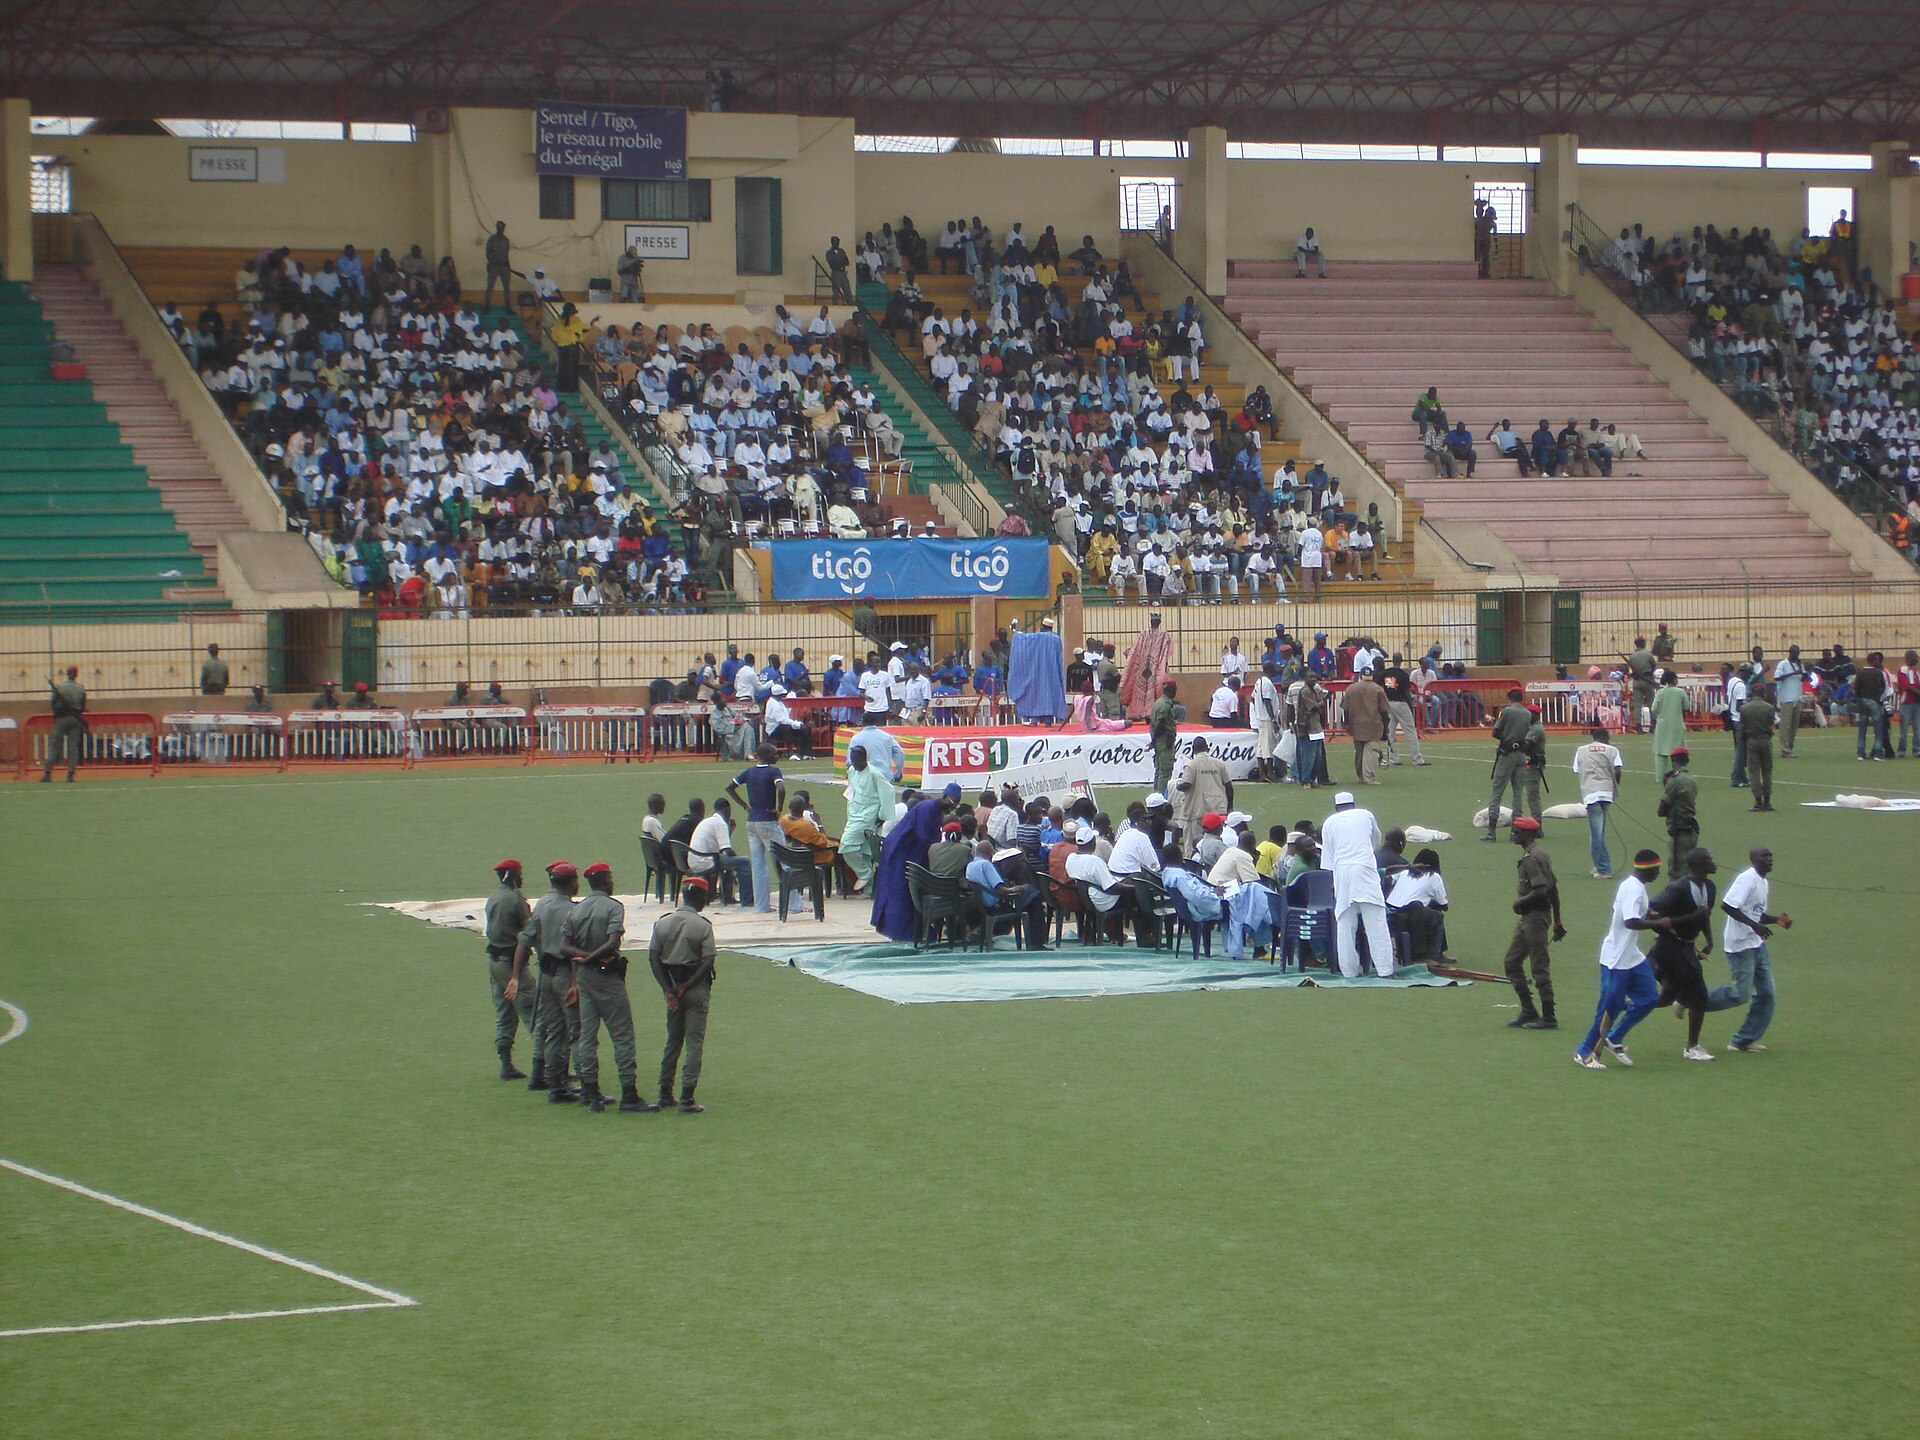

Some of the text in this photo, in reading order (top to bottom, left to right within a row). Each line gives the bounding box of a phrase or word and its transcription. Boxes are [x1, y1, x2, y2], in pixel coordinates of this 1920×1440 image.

[540, 108, 587, 126] Sentel
[602, 111, 638, 132] Tigo,
[540, 128, 663, 150] le réseau mobile
[199, 158, 247, 171] PRESSE
[540, 148, 623, 171] du Sénégal
[635, 236, 677, 249] PRESSE
[1089, 743, 1144, 765] votre
